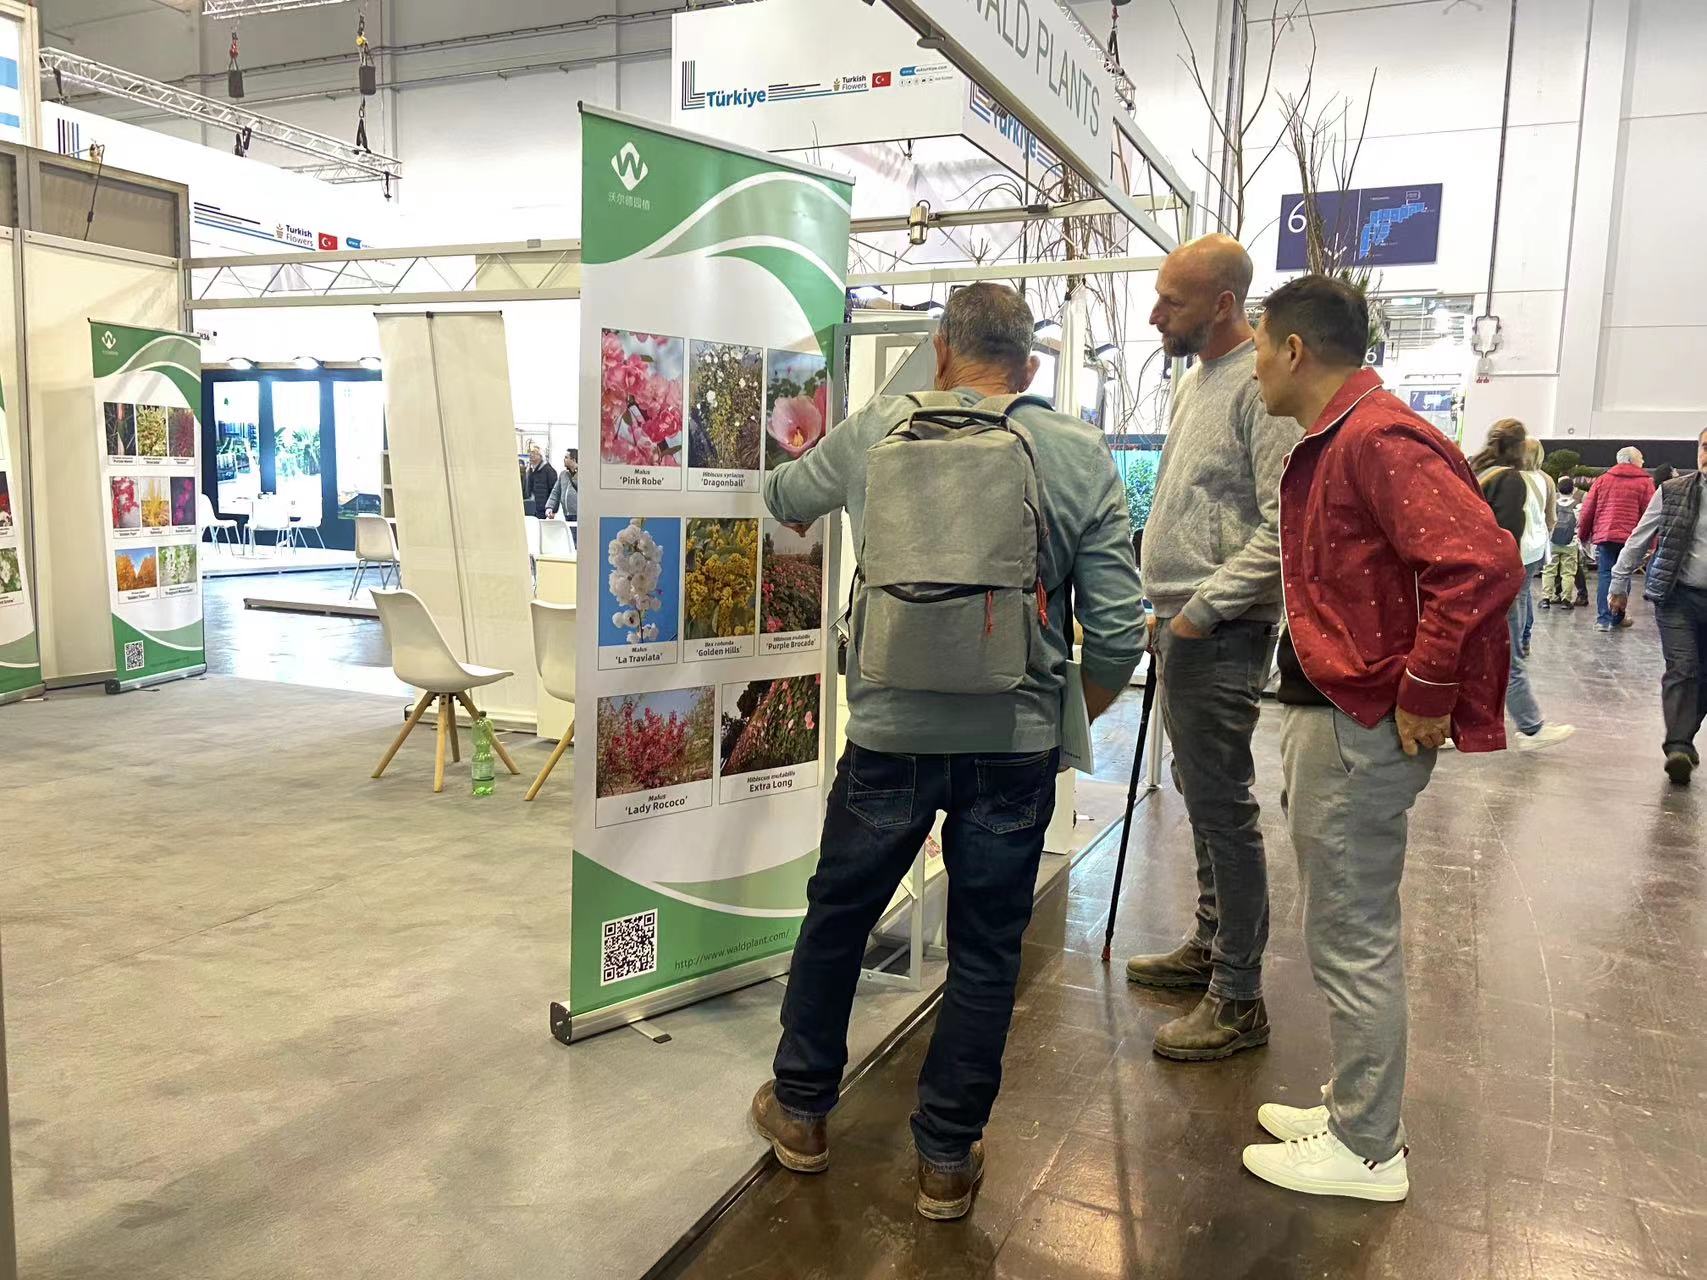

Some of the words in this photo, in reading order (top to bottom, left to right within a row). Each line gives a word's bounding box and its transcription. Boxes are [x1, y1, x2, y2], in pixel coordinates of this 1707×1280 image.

[842, 74, 867, 84] Turkish
[1036, 18, 1100, 137] PLANTS
[842, 82, 867, 91] Flowers
[706, 88, 767, 109] Türkiye
[1288, 200, 1307, 233] 6
[286, 224, 313, 238] Turkish
[286, 233, 314, 247] Flowers
[1412, 392, 1420, 403] 7
[619, 476, 640, 486] 'Pink
[641, 476, 664, 486] Robe'
[696, 646, 723, 657] 'Golden
[724, 645, 743, 655] Hills'
[766, 640, 789, 652] 'Purple
[790, 638, 816, 649] Brocade'
[615, 654, 629, 665] 'La
[630, 652, 663, 663] Traviata'
[749, 781, 770, 793] Extra
[771, 778, 793, 792] Long
[648, 793, 666, 802] Malus
[625, 803, 651, 817] 'Lady
[652, 796, 688, 812] Rococo'
[674, 928, 790, 970] http://www.waldplant.com/
